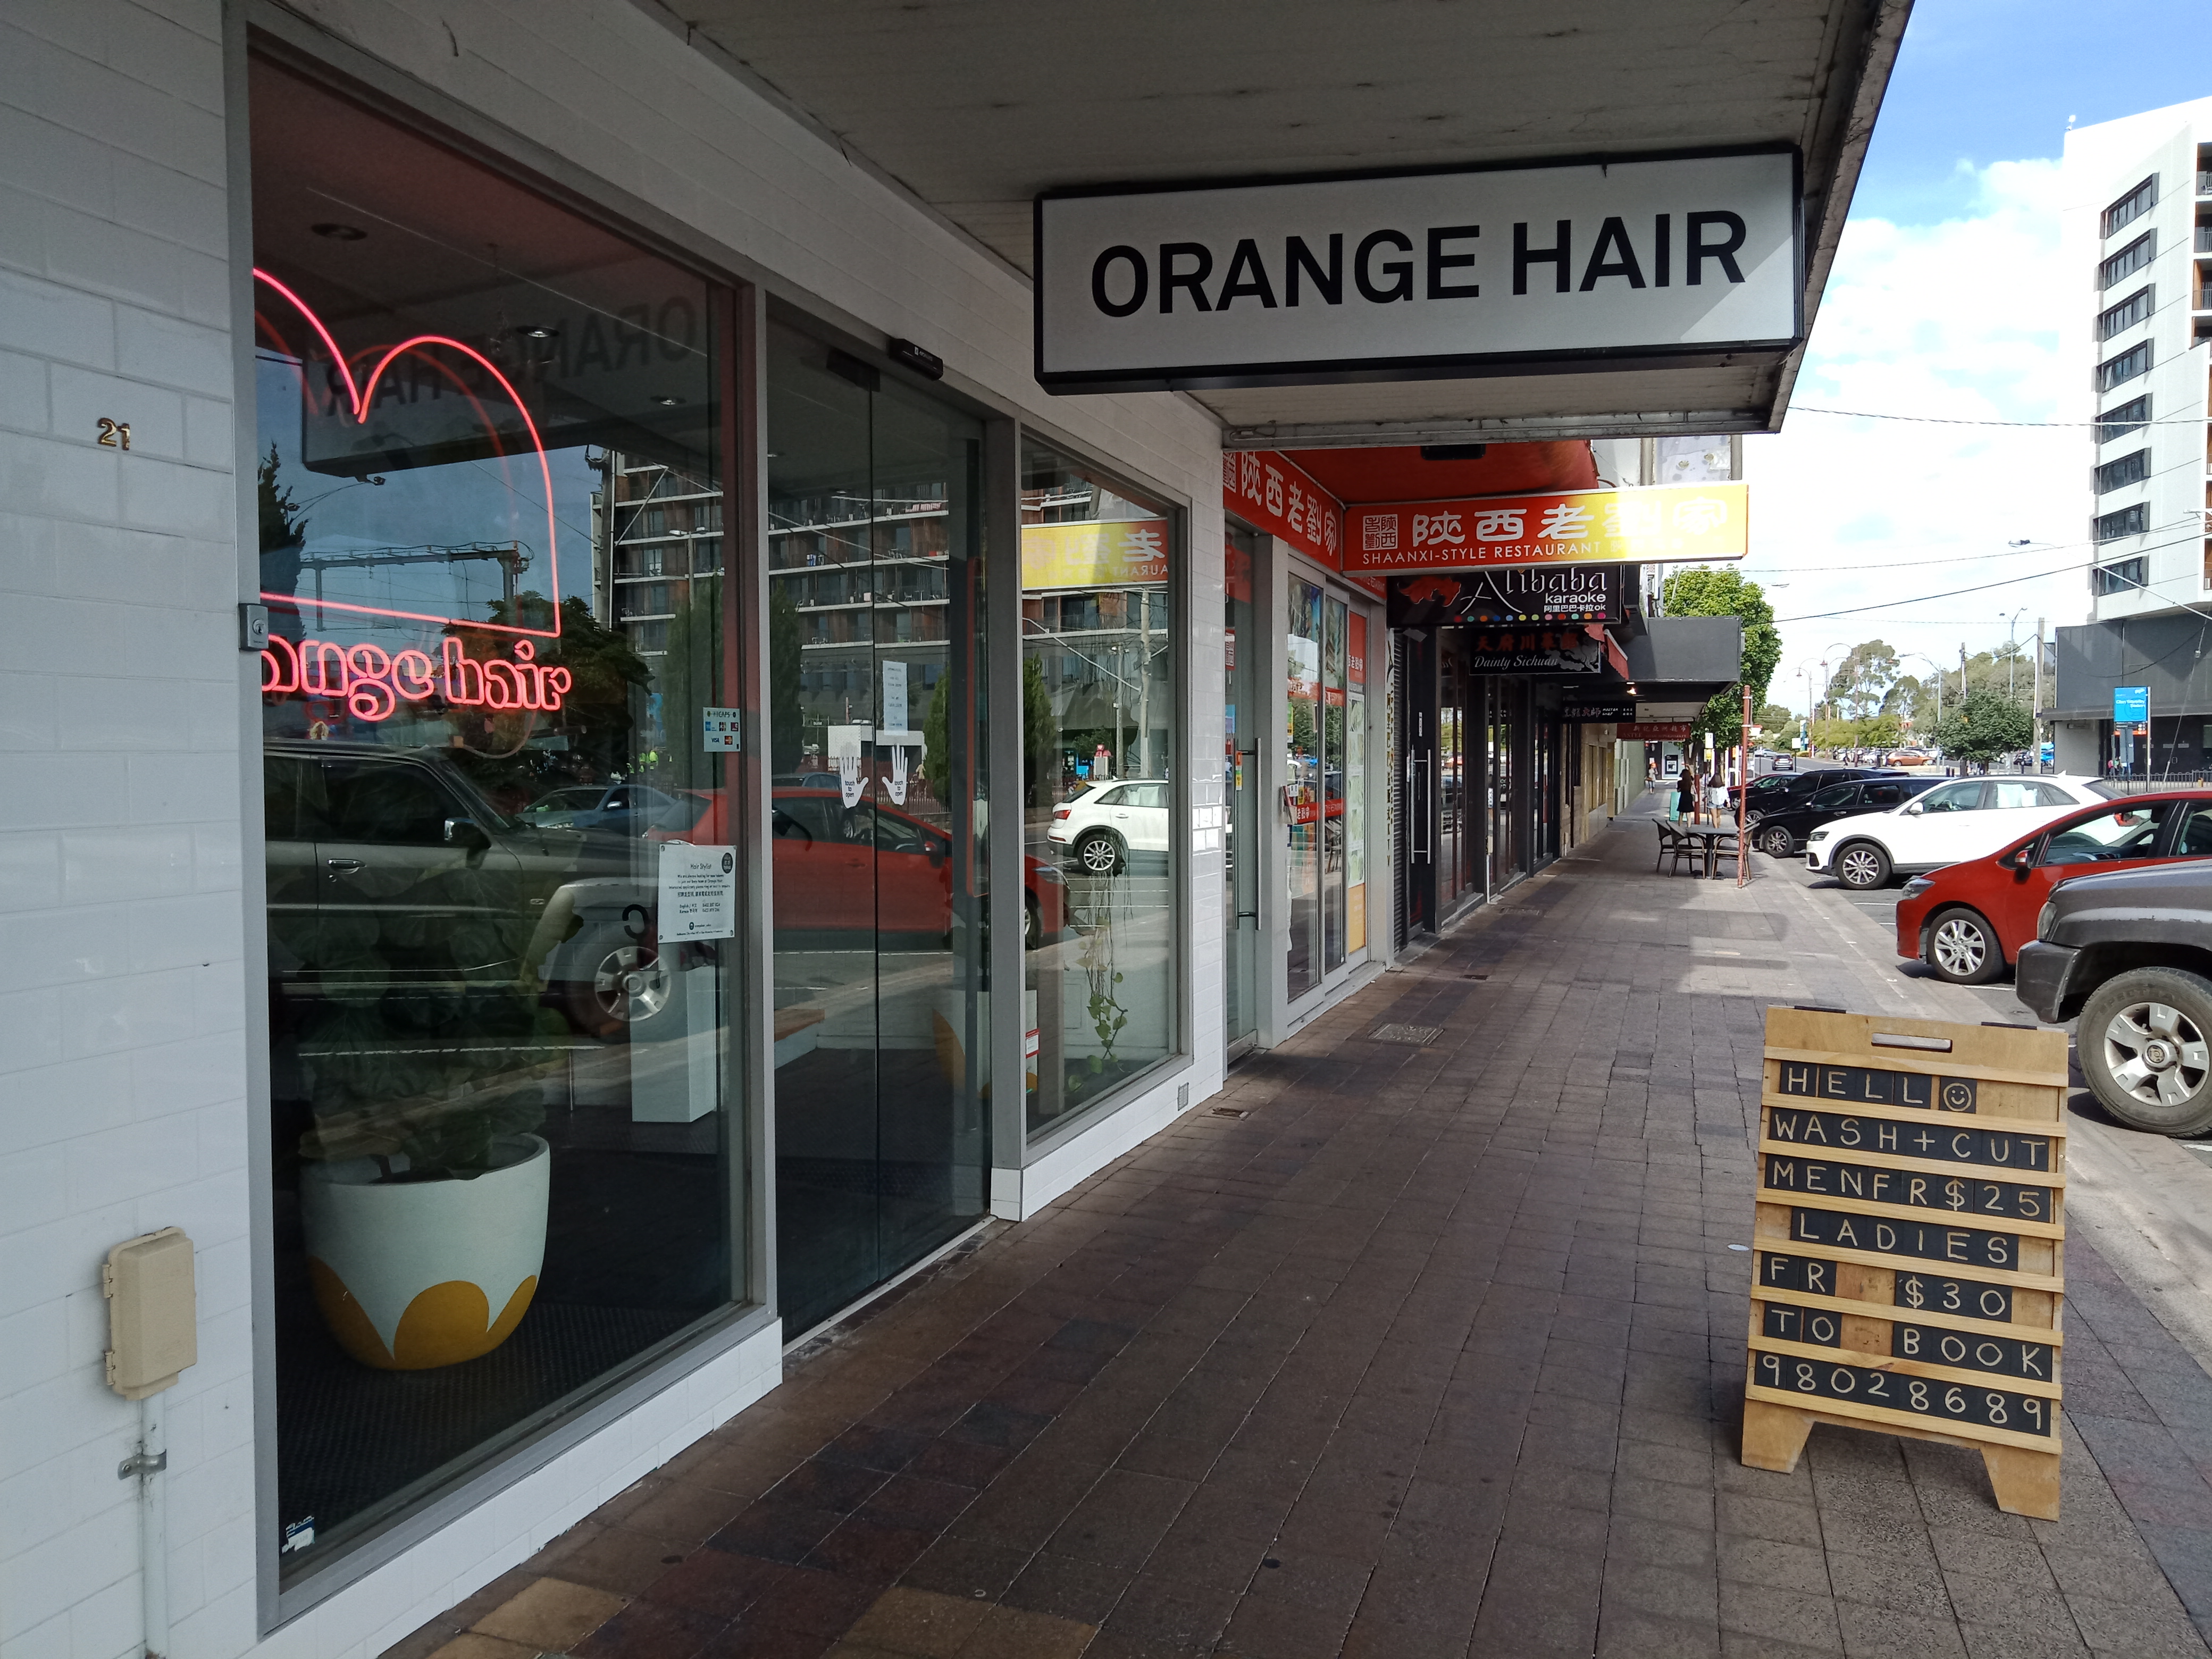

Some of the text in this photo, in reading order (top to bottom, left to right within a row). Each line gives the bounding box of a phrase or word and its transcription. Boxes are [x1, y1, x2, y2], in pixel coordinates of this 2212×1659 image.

[1091, 211, 1746, 318] ORANGE HAIR
[97, 418, 130, 450] 21
[1363, 547, 1486, 565] SHAANXI-STYLE
[1495, 541, 1601, 558] RESTAURANT
[1545, 592, 1606, 604] karaoke
[442, 637, 572, 710] hair
[1474, 655, 1559, 670] Dainty Sichuan
[1799, 1213, 2008, 1264] LADIES
[1771, 1257, 2006, 1316] FR $30
[1771, 1309, 2042, 1377] TO BOOK
[1763, 1354, 2041, 1430] 98028689
